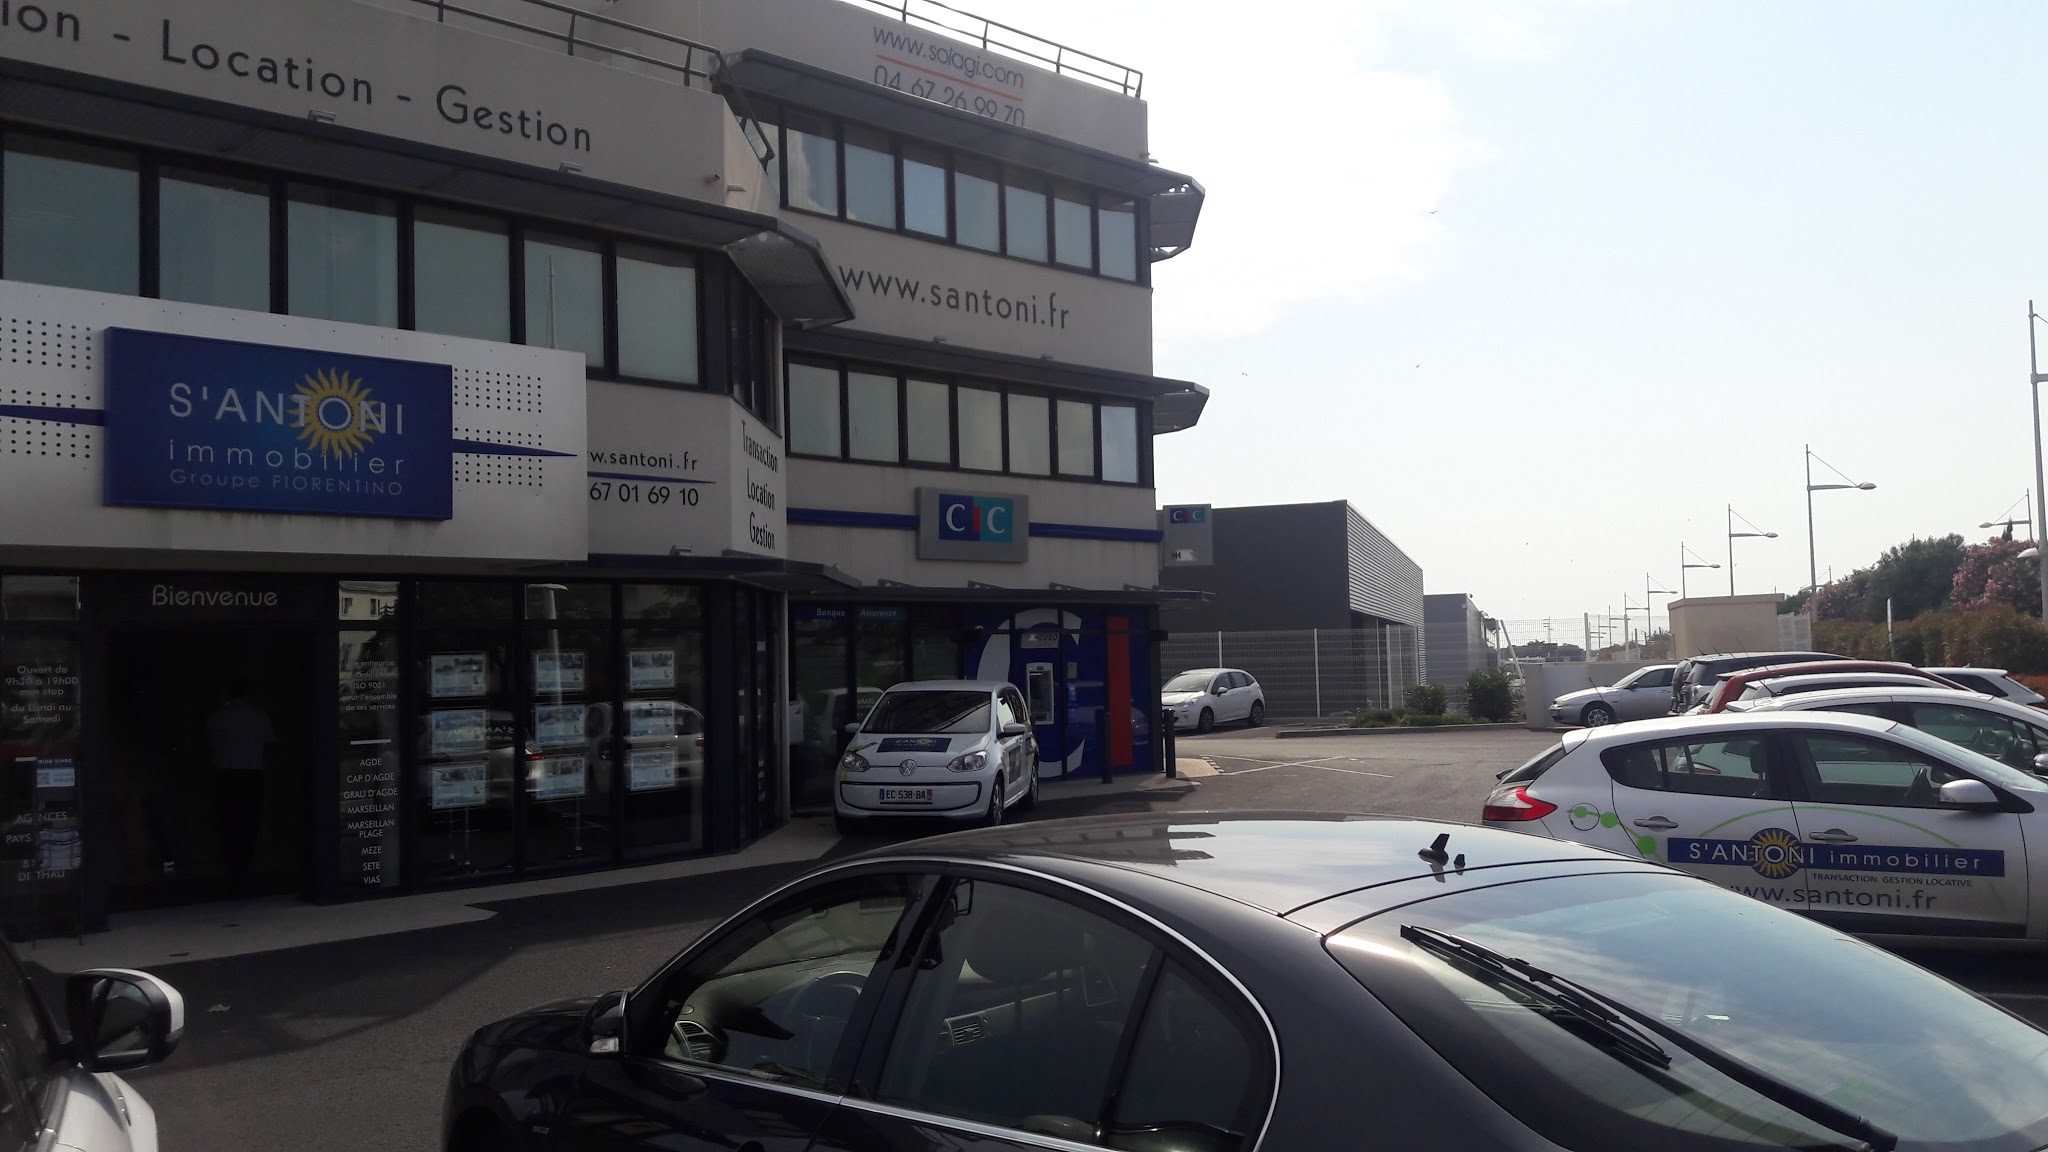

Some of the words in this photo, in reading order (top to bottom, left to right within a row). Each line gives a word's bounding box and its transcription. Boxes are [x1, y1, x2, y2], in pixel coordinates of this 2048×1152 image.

[873, 25, 1024, 89] www.solagi.com
[161, 19, 374, 105] Location
[435, 84, 592, 153] Gestion
[874, 64, 901, 90] 04
[912, 78, 935, 99] 67
[974, 96, 998, 118] 99
[838, 264, 1069, 329] www.santoni.fr
[169, 381, 403, 436] S'ANTONI
[741, 419, 779, 474] Transaction
[168, 439, 404, 476] immobilier
[587, 449, 698, 471] w.santoni.fr
[170, 467, 261, 490] Groupe
[272, 473, 403, 496] FIORENTINO
[590, 481, 611, 501] 67
[619, 484, 639, 503] 01
[648, 486, 670, 505] 69
[679, 488, 699, 507] 10
[747, 467, 776, 511] Location
[945, 503, 1006, 534] CIC
[1172, 509, 1203, 522] CIC
[749, 510, 776, 551] Gestion
[152, 584, 279, 606] Bienvenue
[816, 607, 846, 618] Banque
[860, 607, 897, 617] Assurance
[17, 665, 52, 674] Ouvert
[55, 665, 69, 674] de
[360, 659, 395, 668] entreprise
[5, 676, 33, 686] 9h30
[47, 676, 79, 686] 19h00
[353, 681, 366, 690] ISO
[368, 681, 386, 689] 9001
[43, 688, 64, 697] stop
[360, 692, 398, 701] l'ensemble
[11, 703, 25, 712] du
[28, 703, 56, 712] Lundi
[345, 703, 355, 711] de
[369, 702, 396, 710] services
[22, 715, 61, 724] Samedi
[359, 758, 382, 767] AGDE
[346, 774, 363, 784] CAP
[364, 772, 395, 782] D'AGDE
[343, 790, 366, 799] GRAU
[367, 787, 398, 797] D'AGDE
[347, 803, 395, 814] MARSEILLAN
[15, 811, 67, 824] AGNCES
[347, 818, 395, 830] MARSEILLAN
[6, 833, 32, 844] PAYS
[359, 829, 383, 839] PLAGE
[361, 845, 382, 855] MEZE
[1688, 842, 1815, 864] S'ANTONI
[1829, 848, 1981, 871] immobilier
[362, 861, 381, 871] SETE
[36, 870, 65, 880] THAU
[362, 875, 381, 884] VIAS
[1812, 872, 1878, 884] TRANSACTION
[1882, 875, 1924, 886] GESTION
[1925, 877, 1973, 888] LOCATIVE
